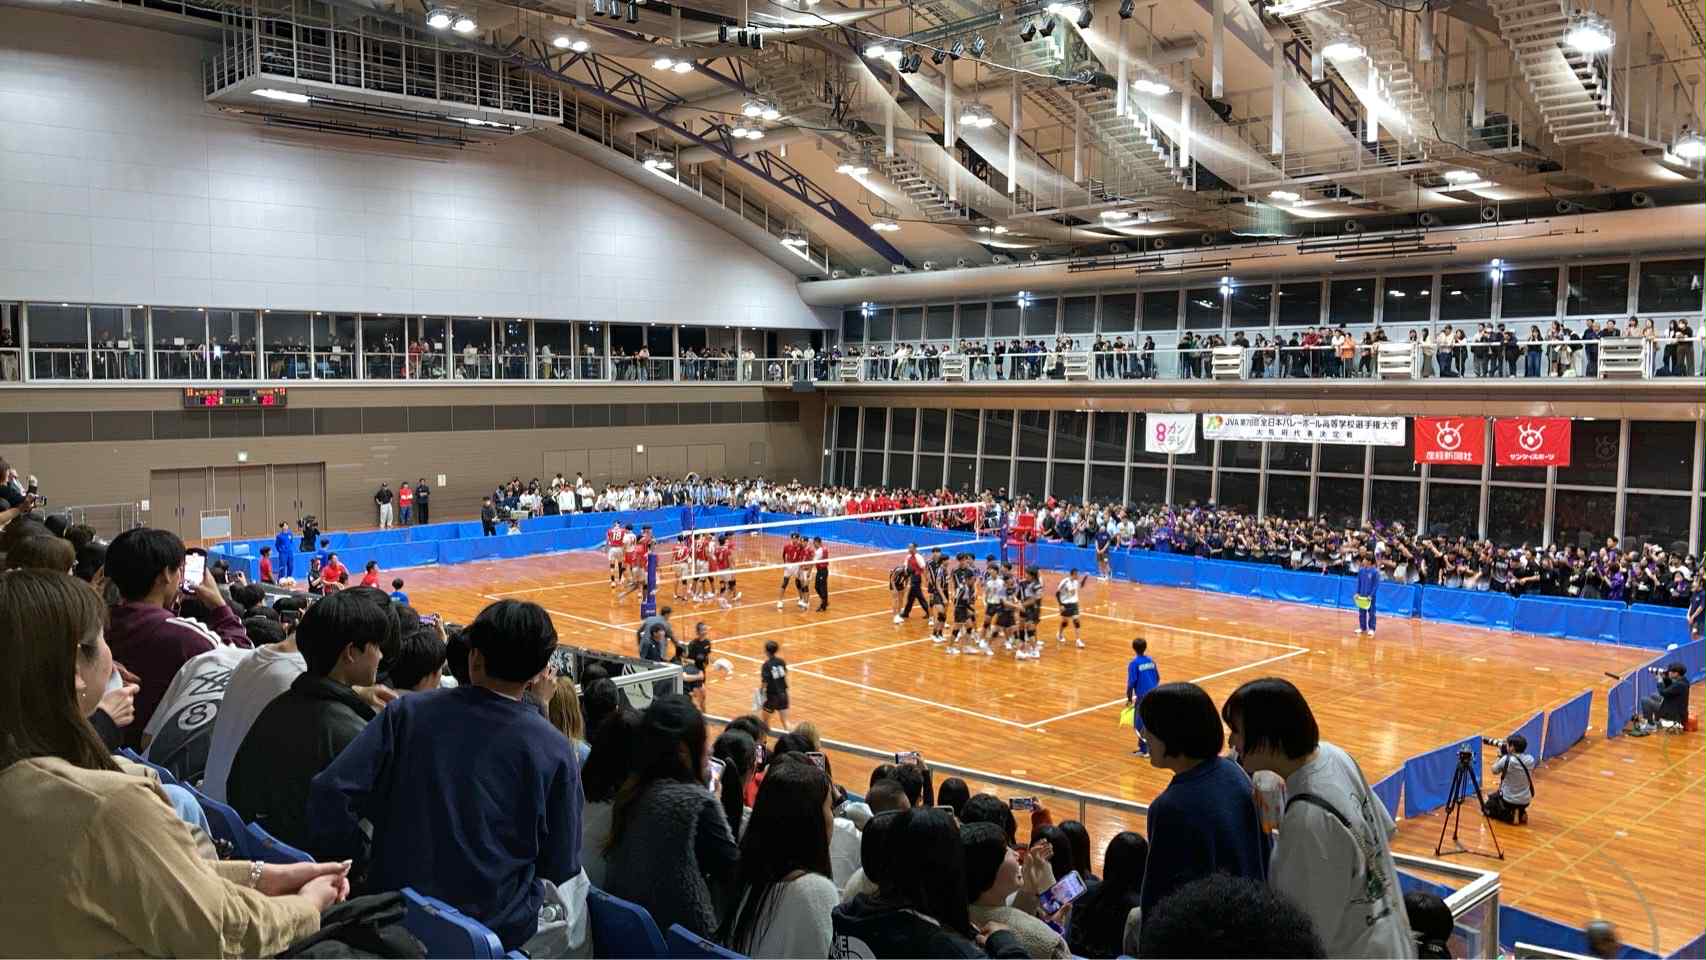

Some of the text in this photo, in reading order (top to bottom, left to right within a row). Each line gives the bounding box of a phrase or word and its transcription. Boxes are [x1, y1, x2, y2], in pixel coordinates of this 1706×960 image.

[1225, 418, 1239, 426] JVA
[1156, 422, 1166, 442] 8
[1509, 453, 1555, 461] サンケイスポーツ
